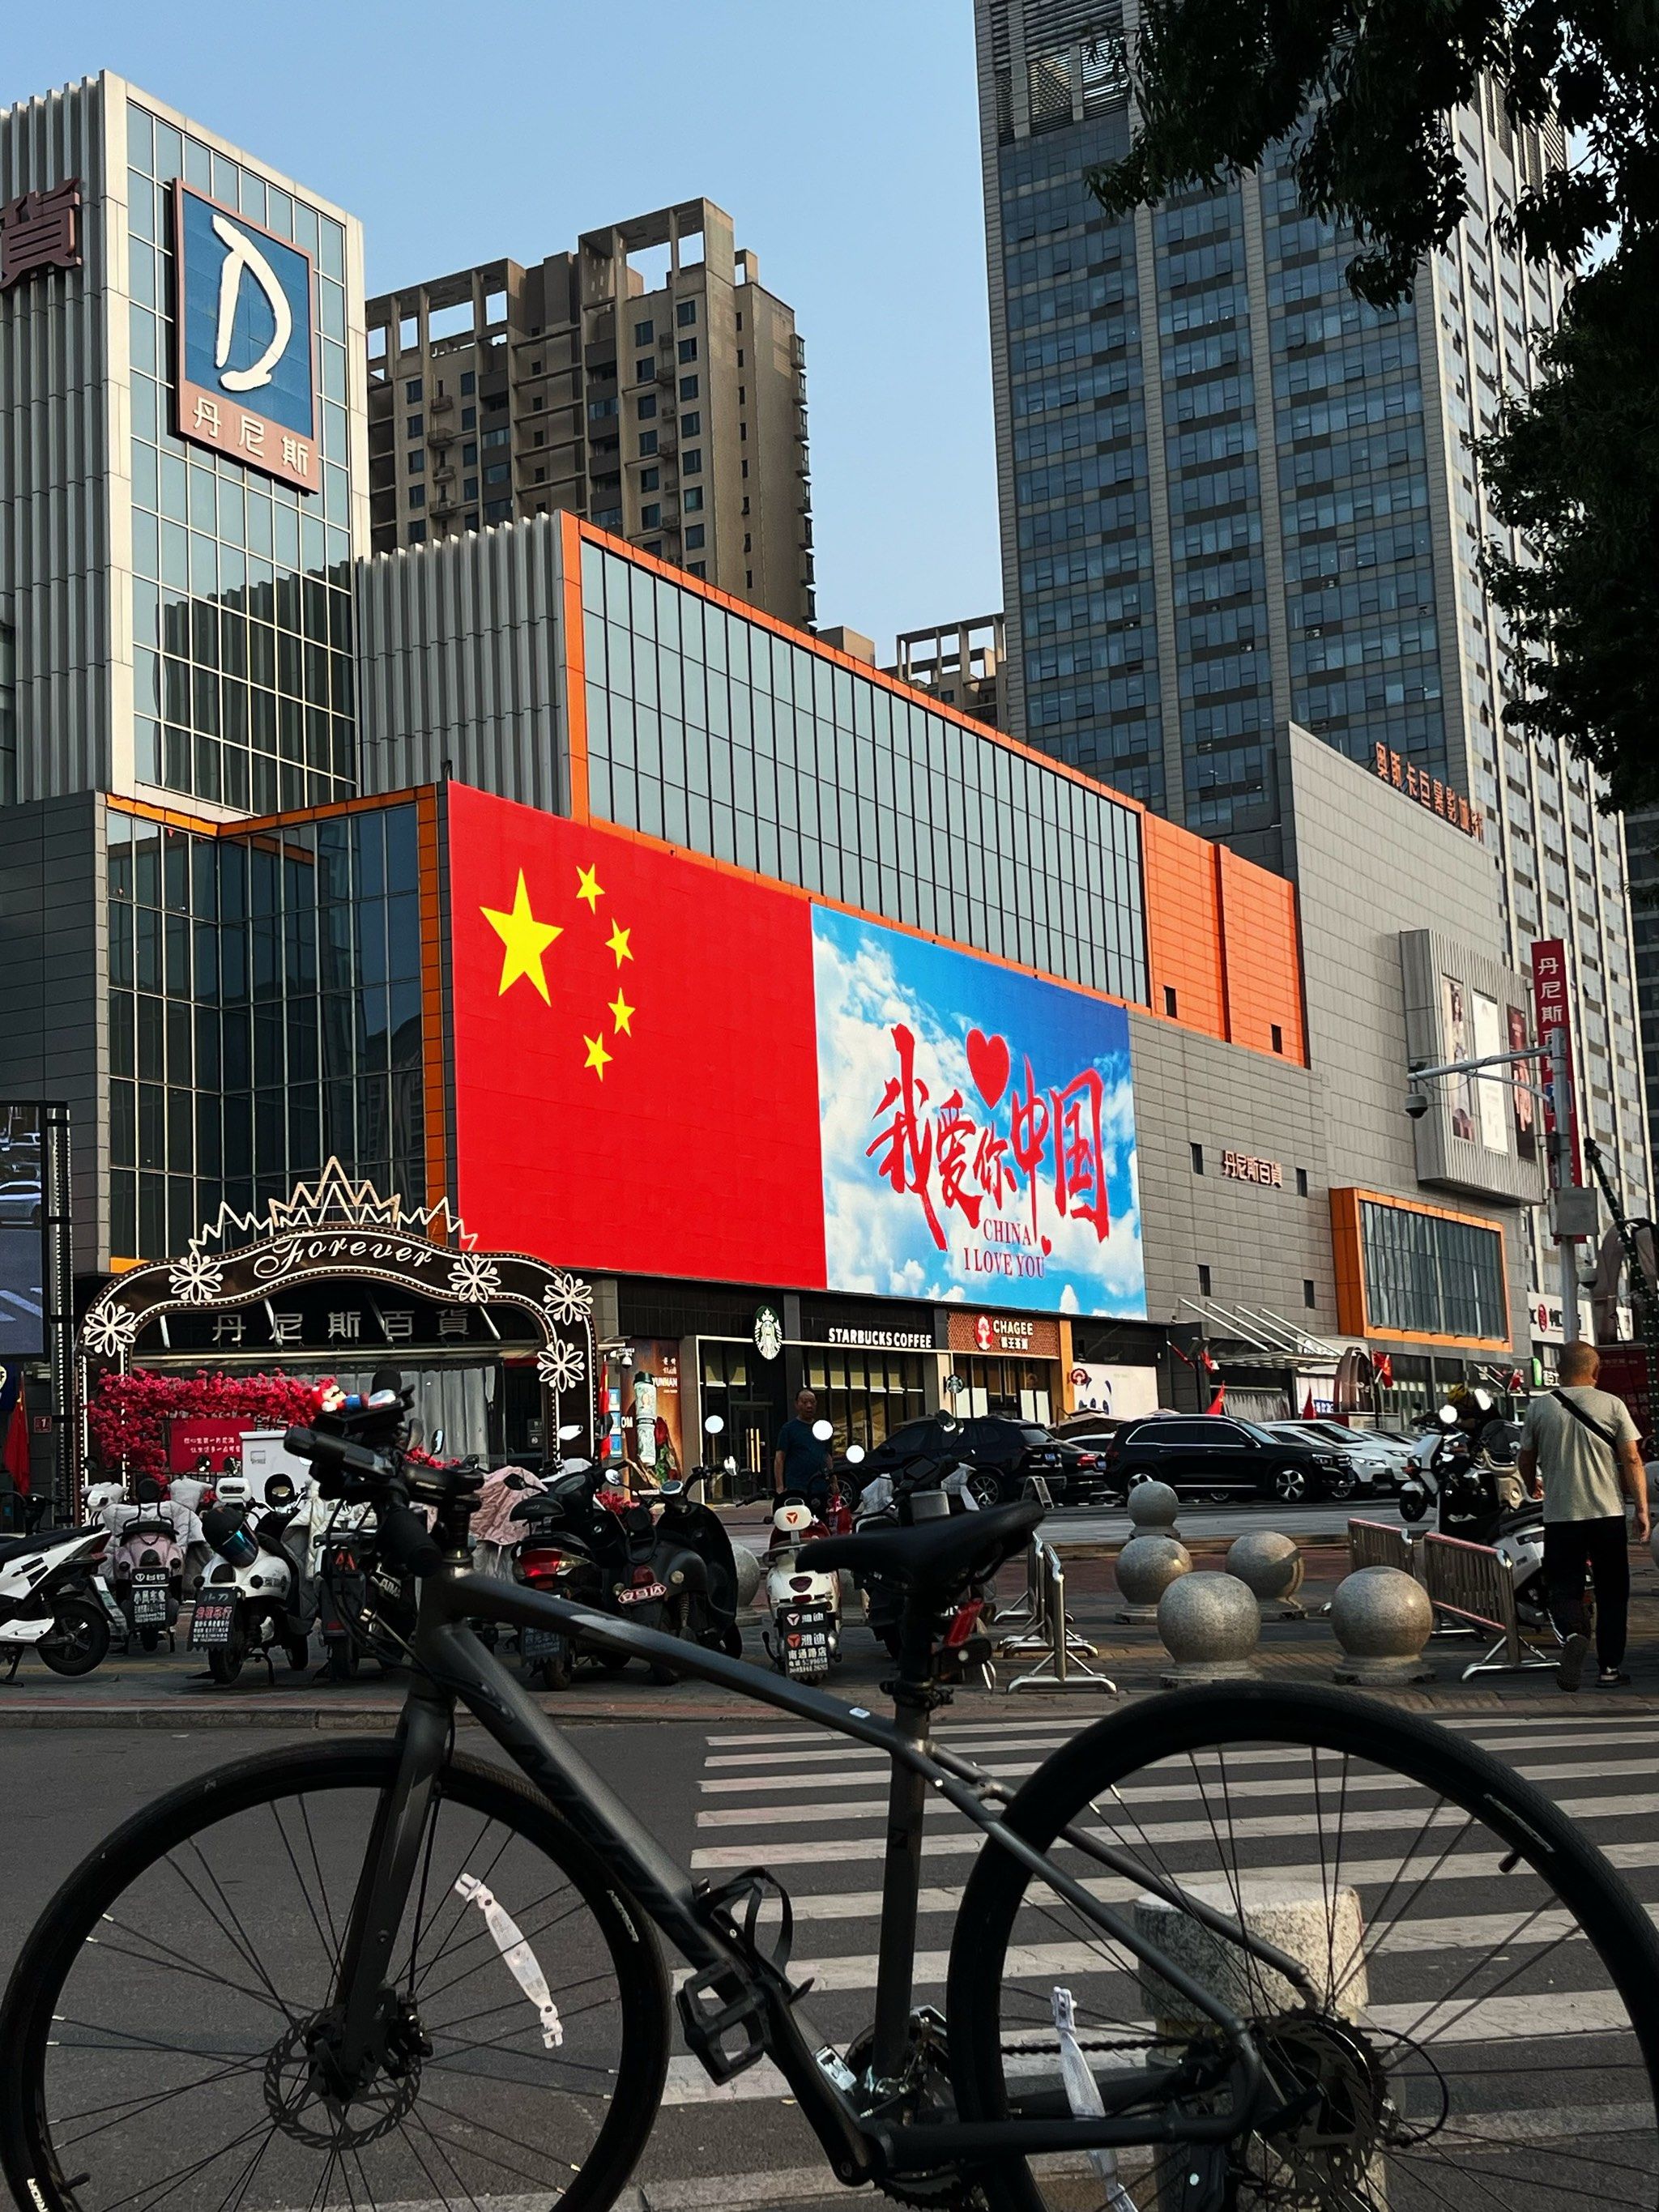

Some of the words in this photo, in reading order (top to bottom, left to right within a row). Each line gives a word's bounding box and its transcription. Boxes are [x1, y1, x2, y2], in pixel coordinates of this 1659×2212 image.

[193, 395, 309, 477] 丹尼斯
[865, 1023, 1111, 1252] 我爱你中国
[983, 1217, 1032, 1247] CHINA
[254, 1236, 432, 1280] Forever
[963, 1247, 970, 1271] I
[974, 1248, 1013, 1276] LOVE
[1016, 1254, 1045, 1278] YOU
[212, 1309, 470, 1341] 丹尼斯百貨
[828, 1328, 893, 1346] STARBUCKS
[893, 1332, 932, 1349] COFFEE
[992, 1319, 1034, 1336] CHAGEE
